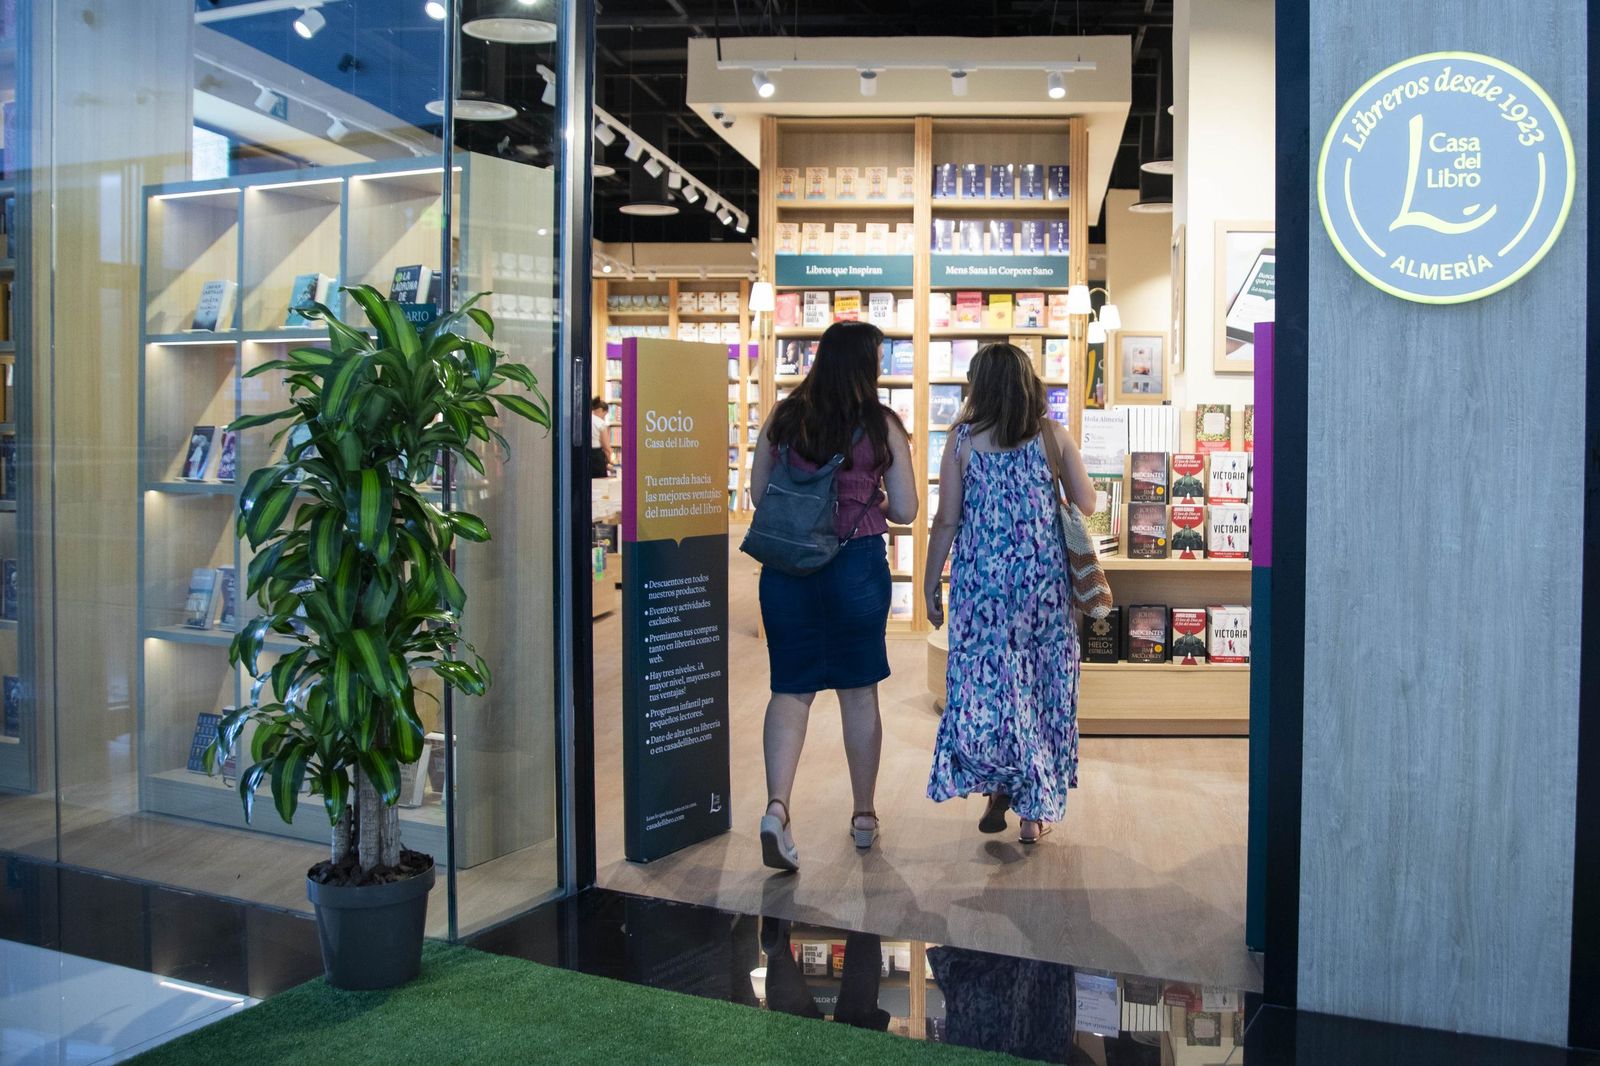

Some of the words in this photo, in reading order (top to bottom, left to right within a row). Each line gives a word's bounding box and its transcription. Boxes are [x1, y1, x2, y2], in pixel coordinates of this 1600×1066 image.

[1342, 74, 1429, 152] Libreros
[1434, 66, 1503, 102] desde
[1498, 93, 1545, 147] 1923
[1429, 132, 1481, 153] Casa
[1453, 153, 1481, 169] del
[1427, 168, 1481, 188] Libro
[806, 265, 832, 276] Libros
[832, 267, 848, 277] que
[848, 265, 883, 277] Inspiran
[945, 266, 967, 275] Mens
[968, 266, 988, 275] Sana
[989, 266, 997, 275] in
[998, 266, 1032, 277] Corpore
[1032, 266, 1054, 275] Sano
[1390, 254, 1493, 280] ALMERÍA
[646, 410, 694, 432] Socio
[645, 438, 664, 448] Casa
[665, 438, 677, 448] del
[679, 438, 699, 448] Libro
[645, 476, 657, 487] Tu
[658, 474, 690, 486] entrada
[691, 473, 712, 484] hacia
[1212, 471, 1245, 480] VICTORIA
[645, 491, 657, 502] las
[658, 491, 691, 504] mejores
[692, 488, 722, 502] ventajas
[645, 507, 658, 518] del
[660, 505, 689, 517] mundo
[690, 504, 702, 515] del
[703, 503, 721, 514] libro
[1213, 524, 1247, 534] VICTORIA
[649, 578, 684, 589] Descuentos
[692, 573, 709, 583] todos
[648, 590, 675, 600] nuestros
[675, 586, 707, 599] productos.
[649, 605, 673, 616] Eventos
[673, 604, 678, 614] y
[678, 600, 711, 611] actividades
[648, 615, 681, 627] exclusivas.
[649, 631, 683, 643] Premiamos
[683, 628, 693, 637] tus
[693, 624, 719, 636] compras
[1214, 629, 1248, 639] VICTORIA
[649, 644, 666, 654] tanto
[696, 636, 713, 645] como
[712, 634, 720, 642] en
[649, 654, 664, 665] web.
[649, 671, 662, 682] Hay
[662, 667, 675, 677] tres
[675, 663, 697, 675] niveles.
[649, 680, 670, 692] mayor
[670, 676, 686, 687] nivel,
[686, 672, 711, 685] mayores
[711, 669, 721, 678] son
[649, 692, 660, 702] tus
[660, 686, 687, 699] ventajas!
[650, 705, 680, 718] Programa
[680, 698, 701, 712] infantil
[701, 697, 714, 709] para
[649, 715, 679, 731] pequeños
[679, 710, 704, 722] lectores.
[650, 734, 665, 745] Date
[665, 732, 674, 742] de
[674, 729, 685, 740] alta
[693, 726, 700, 735] tu
[650, 747, 655, 756] o
[655, 745, 664, 754] en
[663, 733, 712, 752] casadellibro.com
